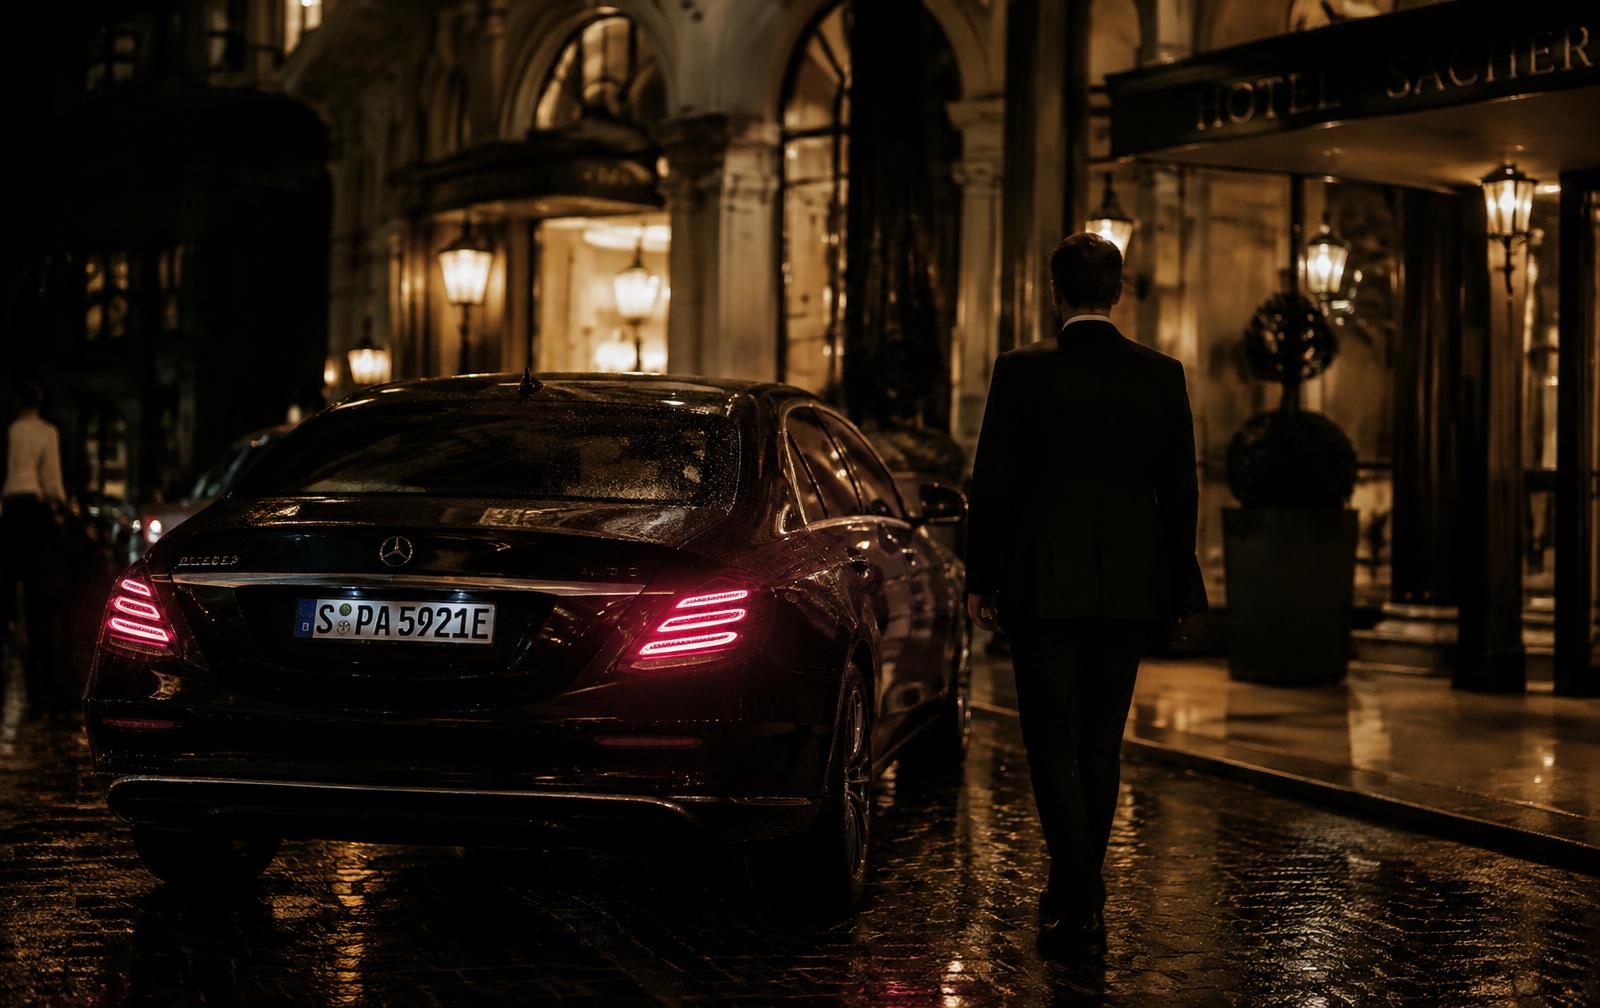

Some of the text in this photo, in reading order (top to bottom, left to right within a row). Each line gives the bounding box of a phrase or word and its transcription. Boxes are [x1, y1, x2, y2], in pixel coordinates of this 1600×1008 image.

[1195, 70, 1343, 132] HOTEL
[315, 603, 490, 640] S PA 5921E
